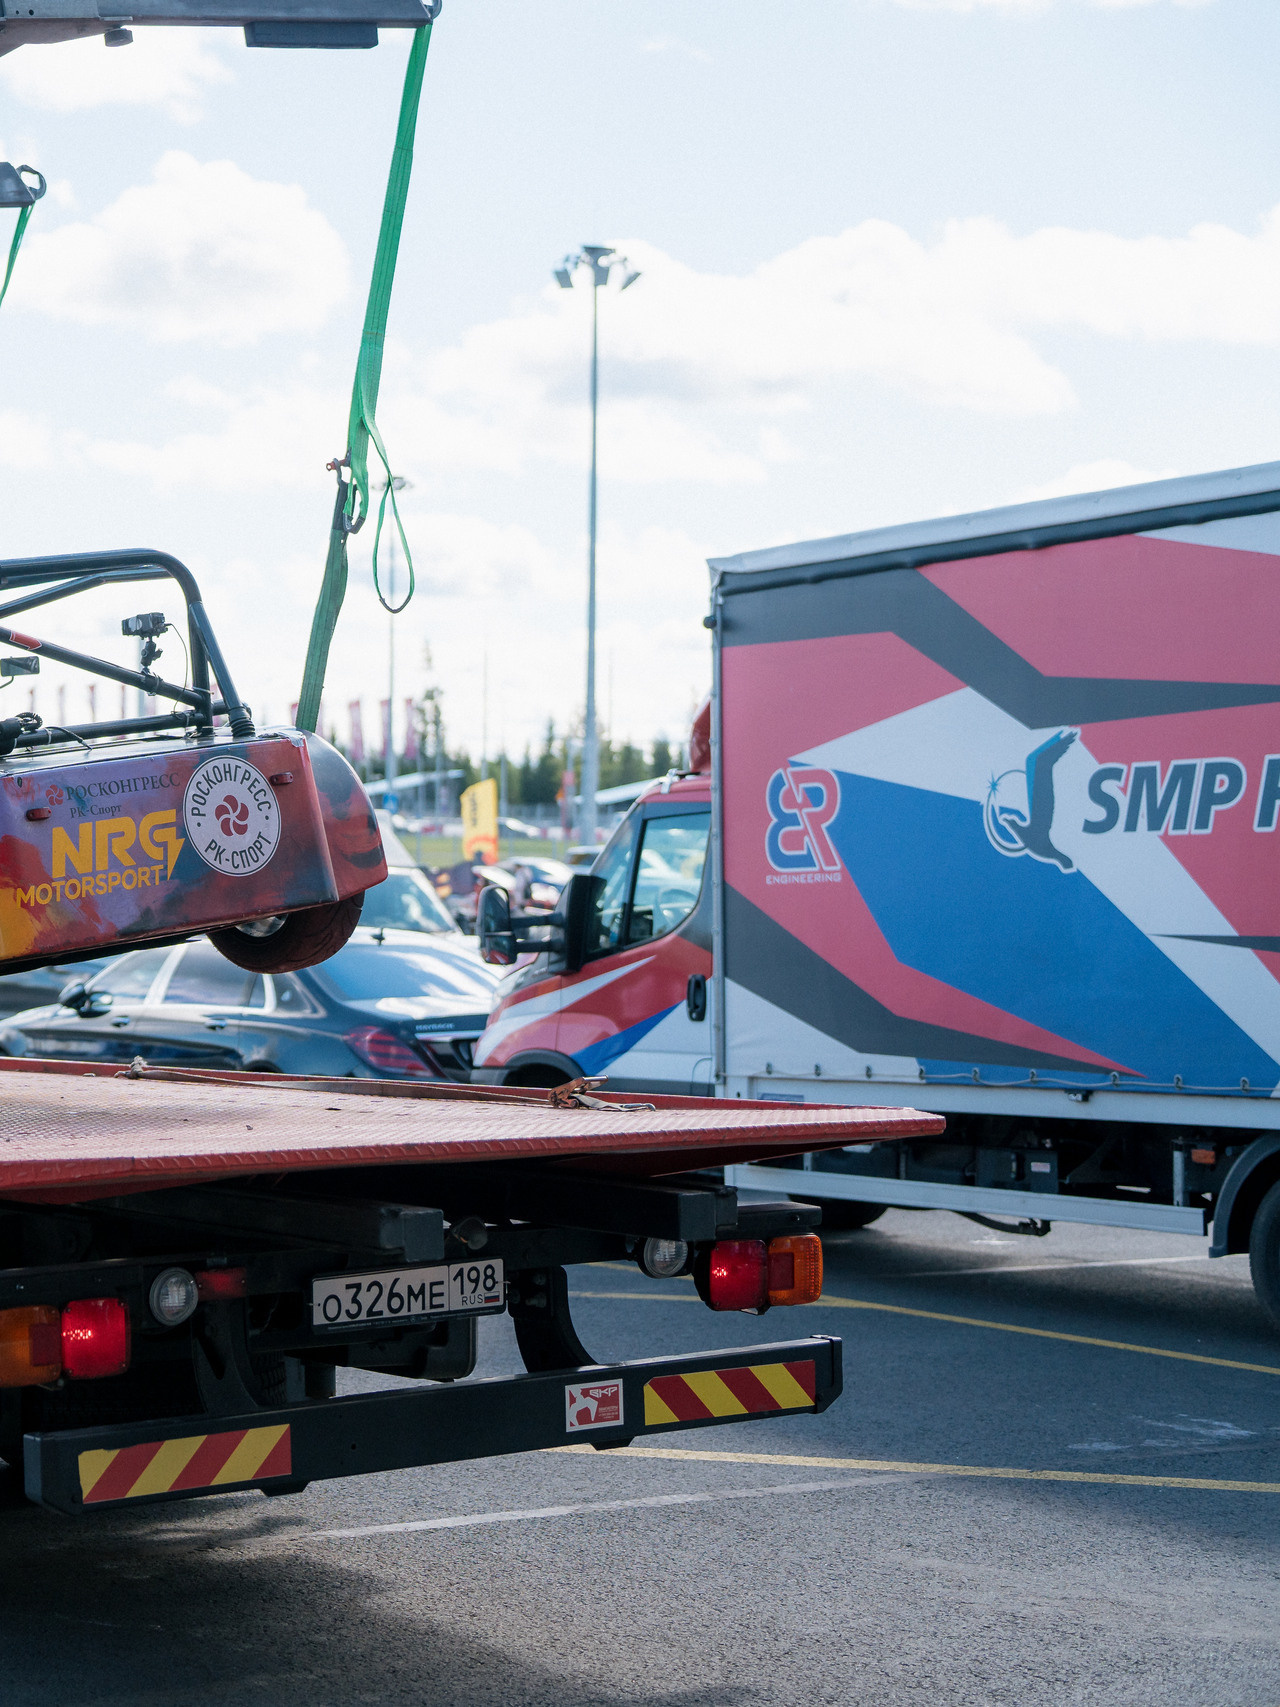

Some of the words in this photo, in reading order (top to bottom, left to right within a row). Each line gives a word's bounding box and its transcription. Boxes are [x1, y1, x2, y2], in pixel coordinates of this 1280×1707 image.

[67, 772, 181, 801] РОСКОНГРЕСС
[191, 763, 272, 817] РОСКОНГРЕСС
[1082, 757, 1247, 835] SMP
[70, 804, 122, 819] РК-Спорт
[52, 809, 185, 880] NRG
[204, 832, 272, 869] РК-СПОРТ
[16, 864, 164, 909] MOTORSPORT
[766, 872, 842, 884] ENGINEERING
[453, 1264, 496, 1296] 198
[462, 1293, 484, 1306] RUS
